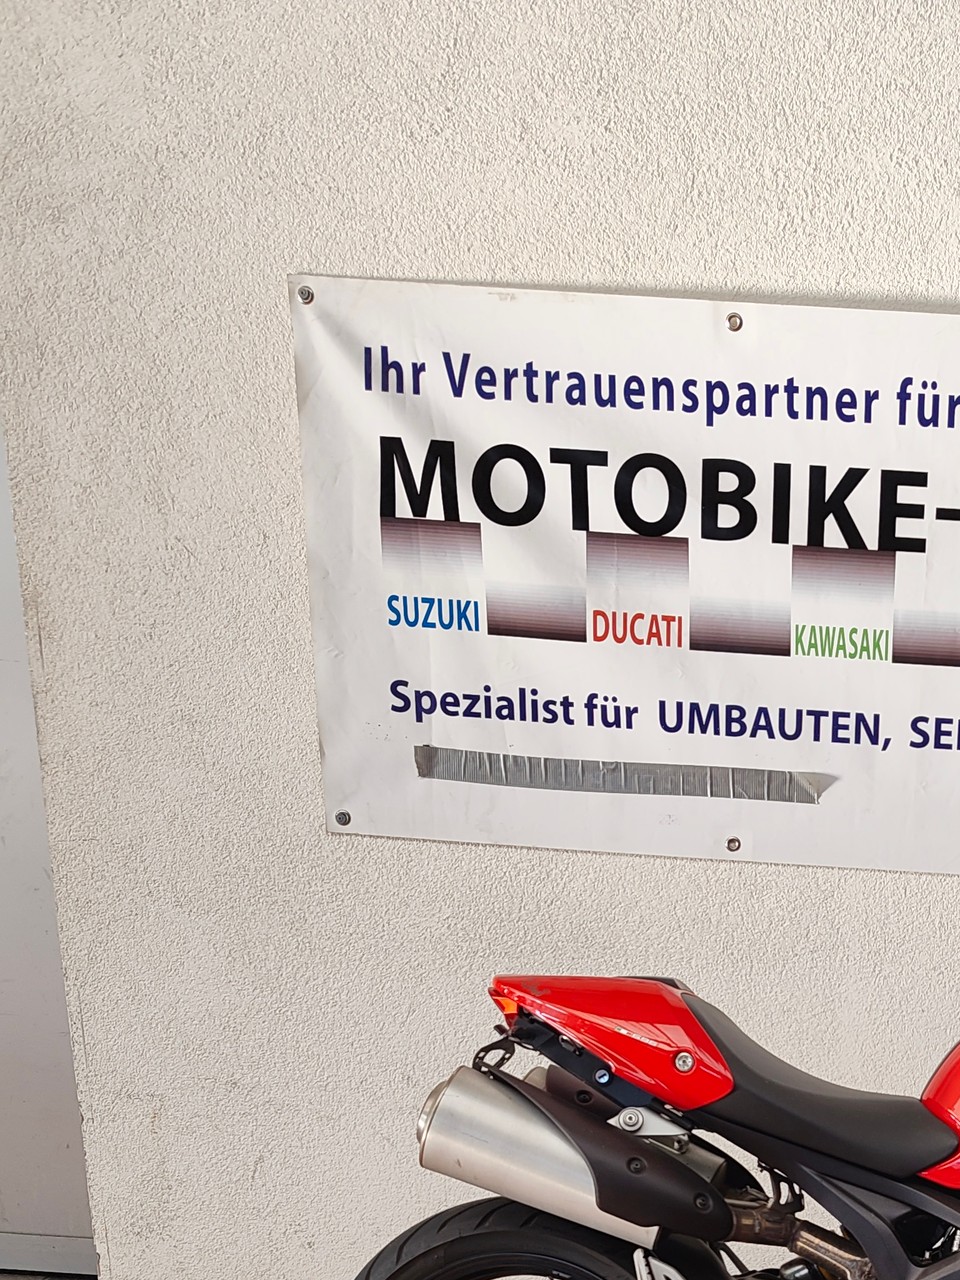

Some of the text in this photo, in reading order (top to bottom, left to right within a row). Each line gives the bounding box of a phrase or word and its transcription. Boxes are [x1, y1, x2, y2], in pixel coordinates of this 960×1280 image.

[365, 346, 425, 395] Ihr
[443, 352, 878, 426] Vertrauenspartner
[388, 595, 479, 631] SUZUKI
[593, 610, 682, 647] DUCATI
[796, 624, 889, 662] KAWASAKI
[390, 680, 574, 724] Spezialist
[585, 693, 638, 729] für
[659, 701, 891, 751] UMBAUTEN,
